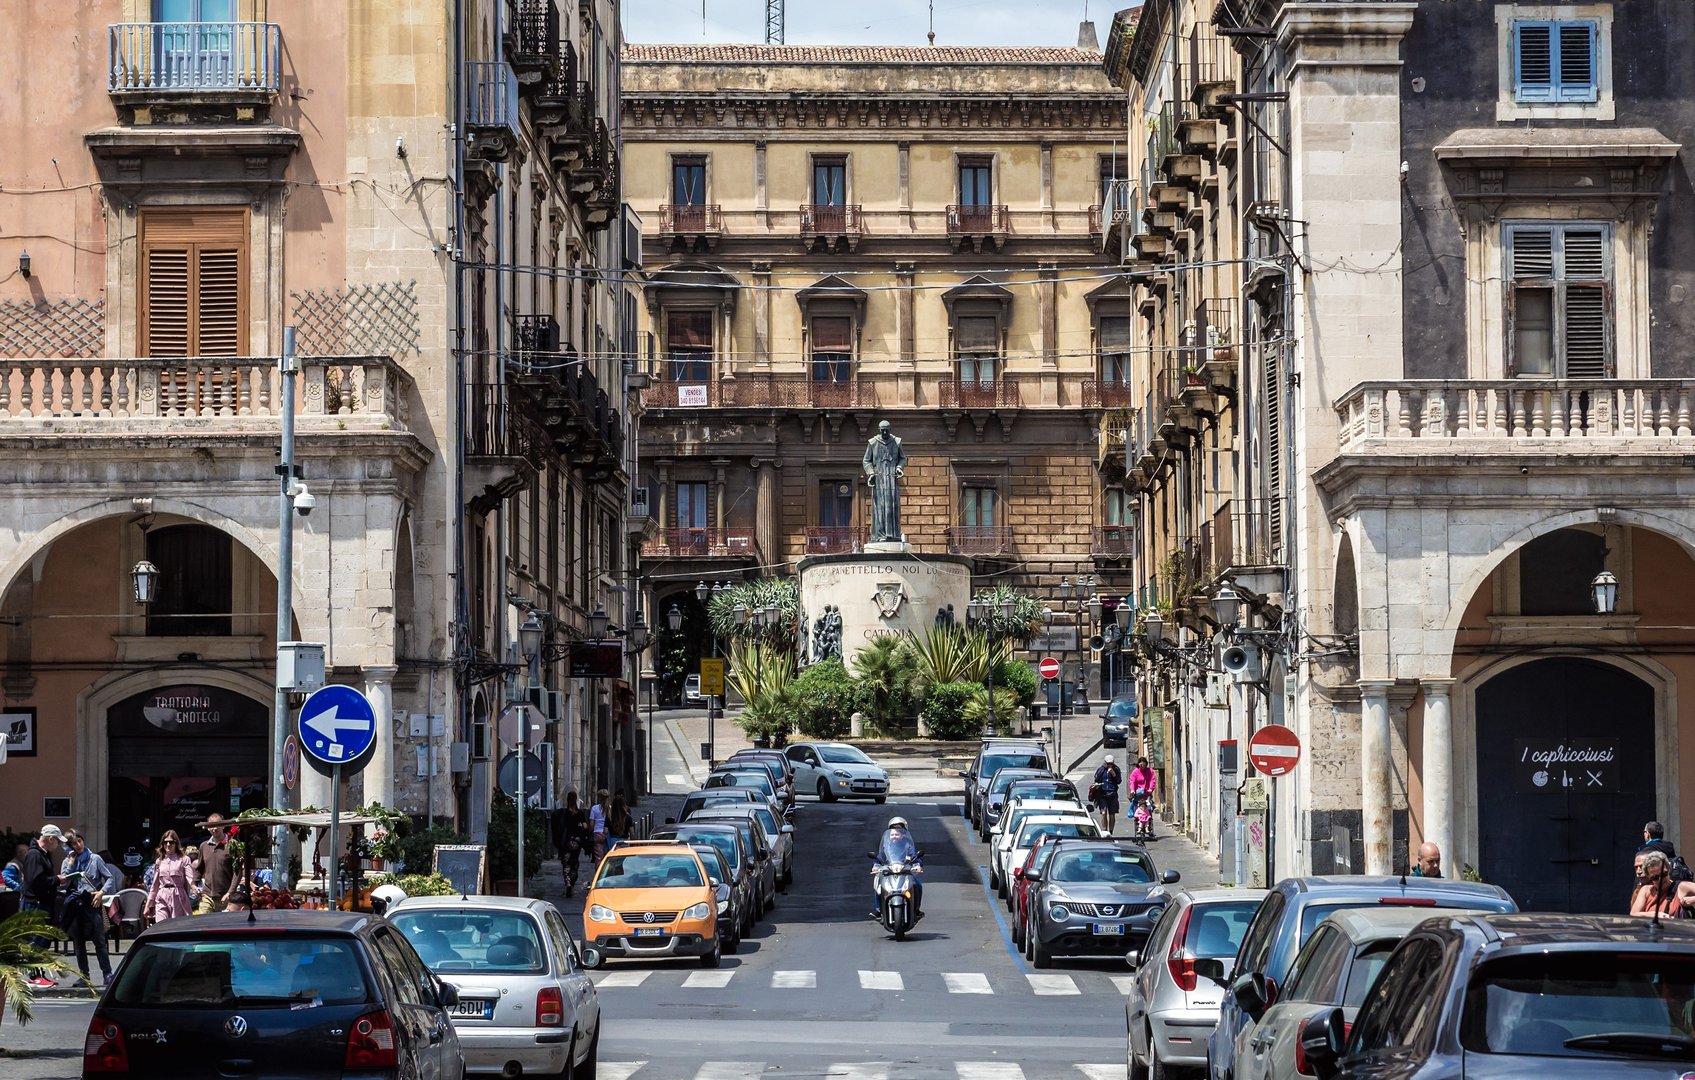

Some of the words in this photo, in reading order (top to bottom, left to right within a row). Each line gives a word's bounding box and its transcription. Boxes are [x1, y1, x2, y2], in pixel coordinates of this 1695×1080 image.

[902, 565, 919, 574] NOI
[155, 696, 210, 708] TRATTORIA
[176, 711, 220, 723] ENOTECA
[1531, 744, 1614, 768] capricciusi
[446, 1001, 484, 1015] 76DW
